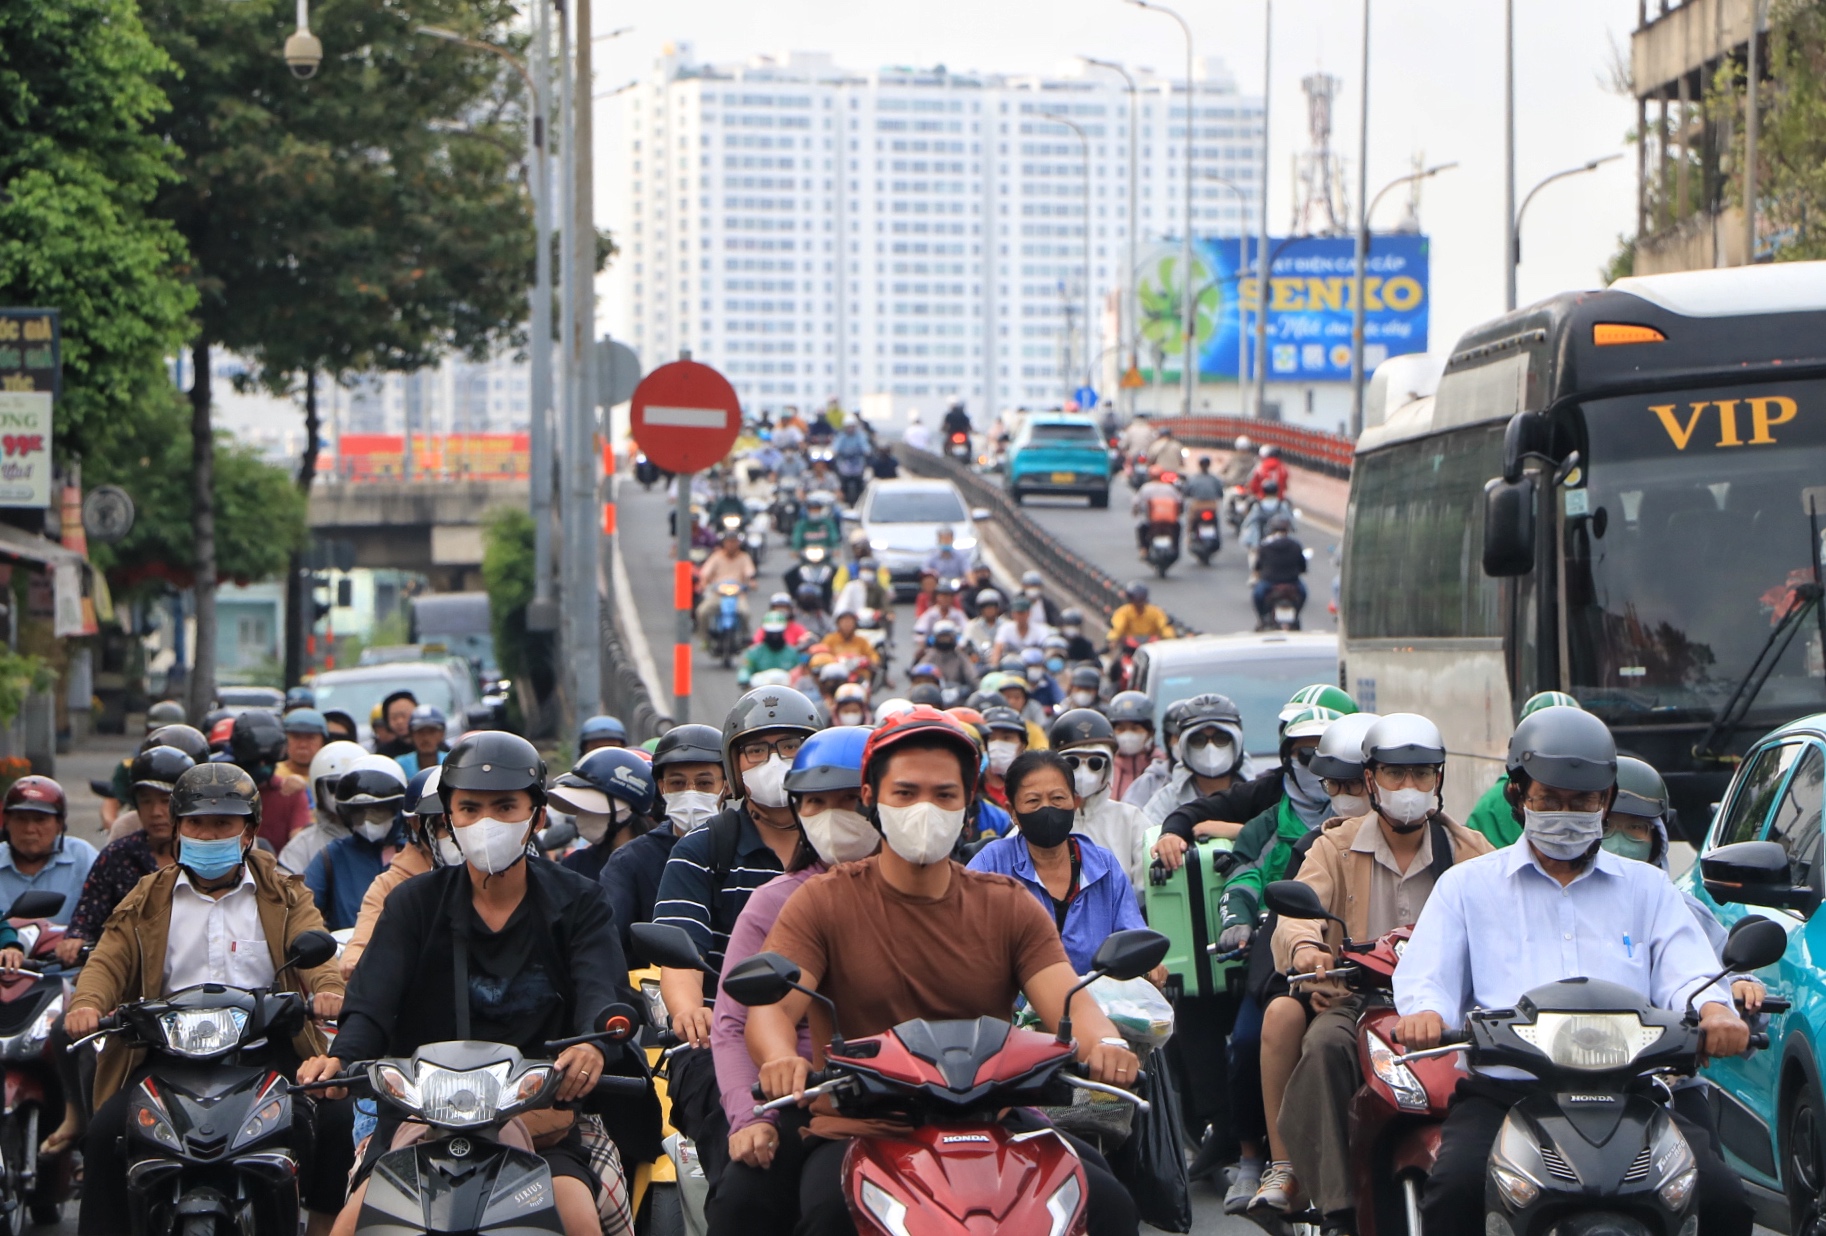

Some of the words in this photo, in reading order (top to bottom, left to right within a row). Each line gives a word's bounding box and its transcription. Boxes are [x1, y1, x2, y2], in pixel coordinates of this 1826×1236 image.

[1238, 276, 1423, 311] SENKO
[1647, 396, 1798, 450] VIP
[1570, 1094, 1616, 1102] HONDA
[942, 1134, 990, 1143] HONDA
[514, 1182, 542, 1203] SIRIUS
